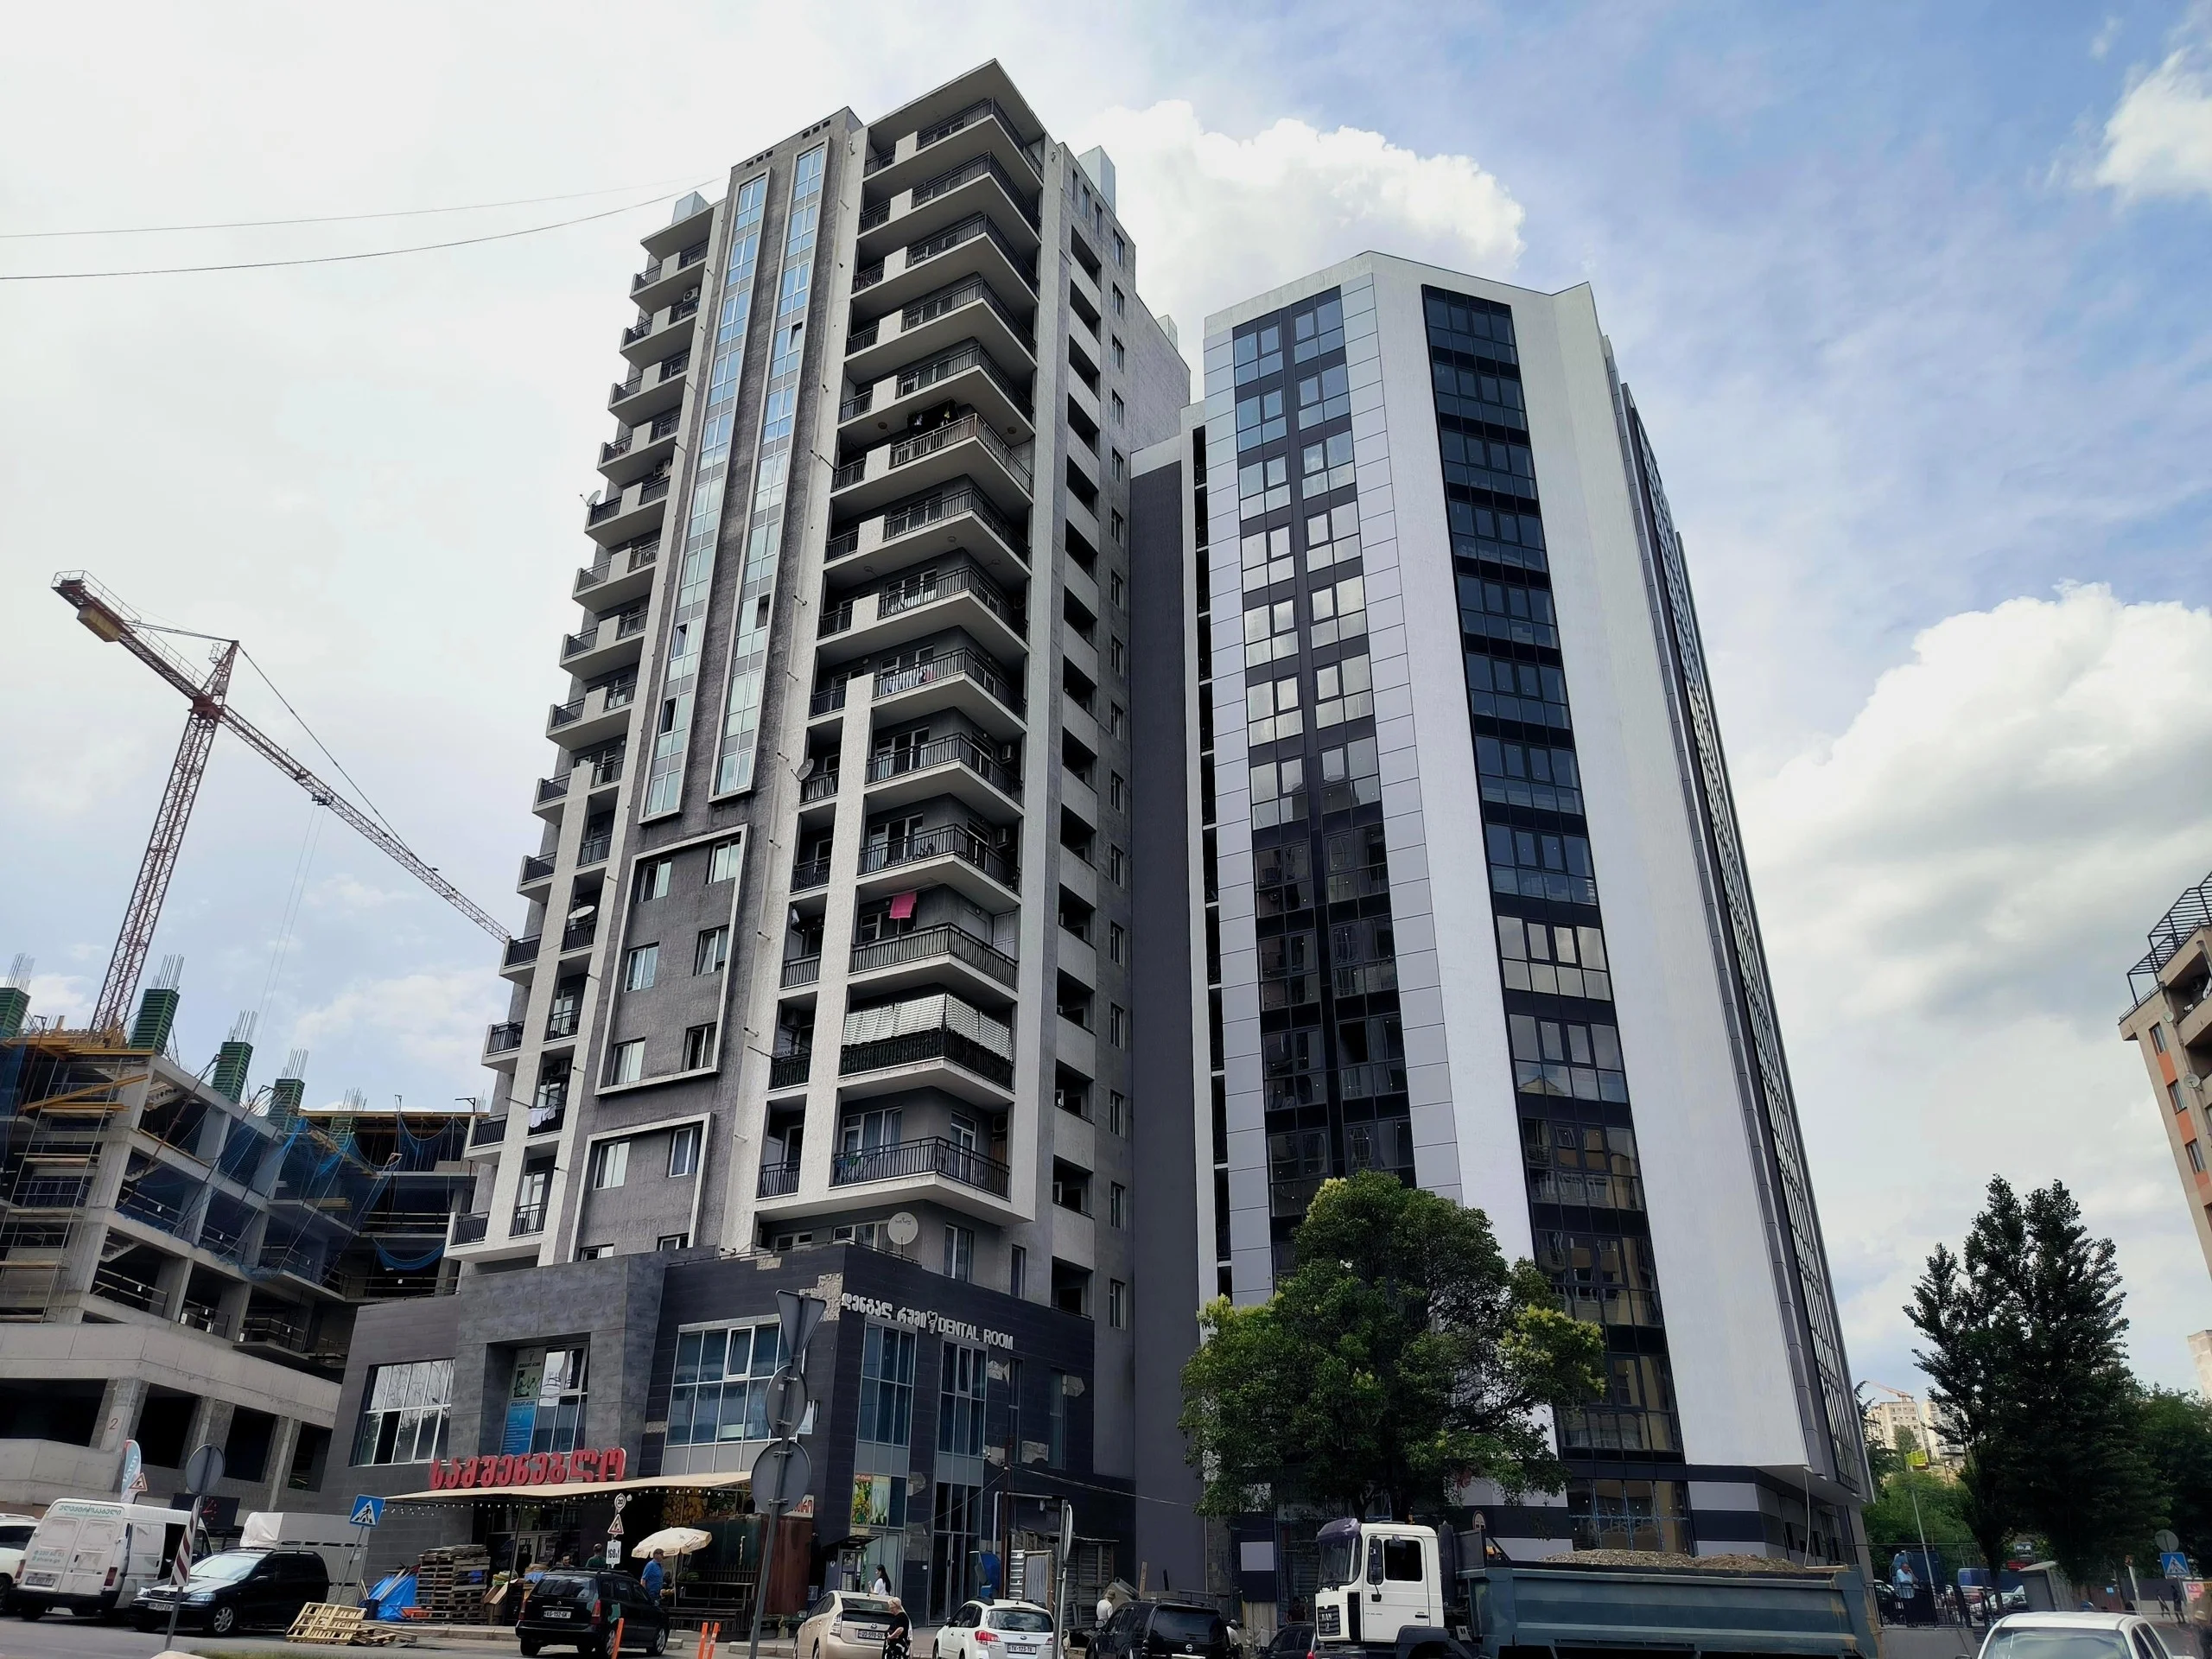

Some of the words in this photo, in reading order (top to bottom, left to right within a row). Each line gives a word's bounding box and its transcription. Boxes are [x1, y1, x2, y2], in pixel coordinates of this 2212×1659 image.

[842, 1292, 893, 1320] დენტალ
[938, 1317, 980, 1341] DENTAL
[983, 1329, 1014, 1351] ROOM
[429, 1447, 627, 1490] სამშენებლო
